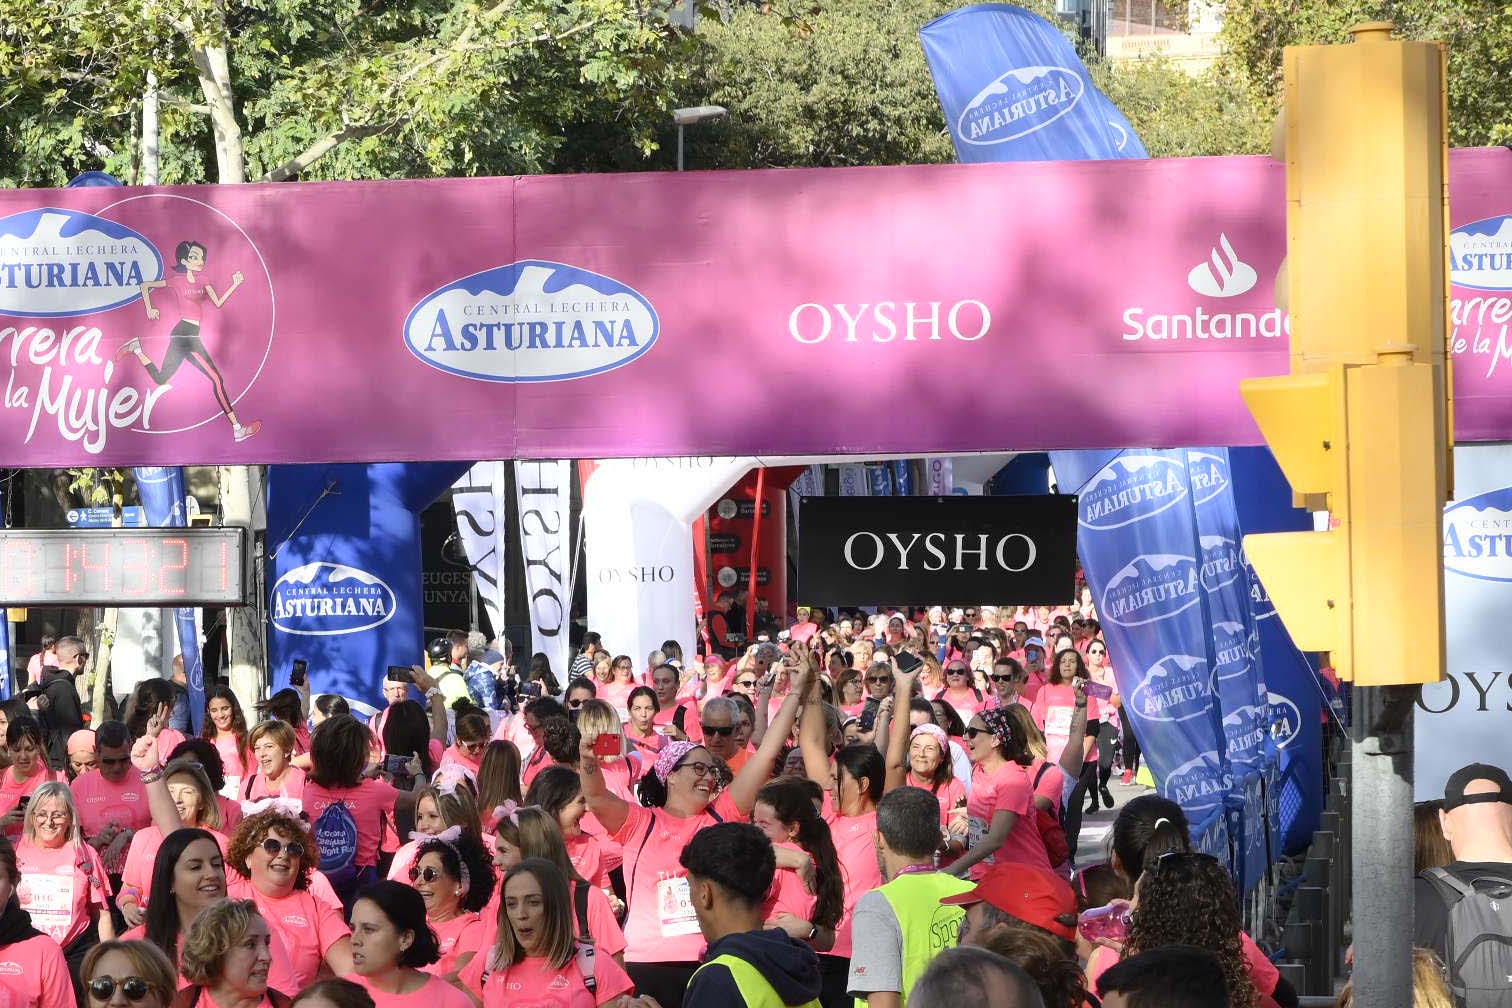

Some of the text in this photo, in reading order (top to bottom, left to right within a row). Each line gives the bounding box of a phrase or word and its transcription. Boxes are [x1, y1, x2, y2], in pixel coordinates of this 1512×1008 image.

[66, 244, 138, 255] LECHERA
[464, 300, 631, 316] CENTRAL LECHERA
[788, 299, 992, 344] OYSHO
[1122, 306, 1291, 341] Santand
[424, 308, 639, 352] ASTURIANA
[4, 368, 30, 409] la
[24, 359, 174, 455] Mujer
[844, 531, 1038, 573] OYSHO
[598, 566, 674, 582] OYSHO
[274, 592, 386, 619] ASTURIANA
[286, 586, 382, 596] CENTRAL LECHERA
